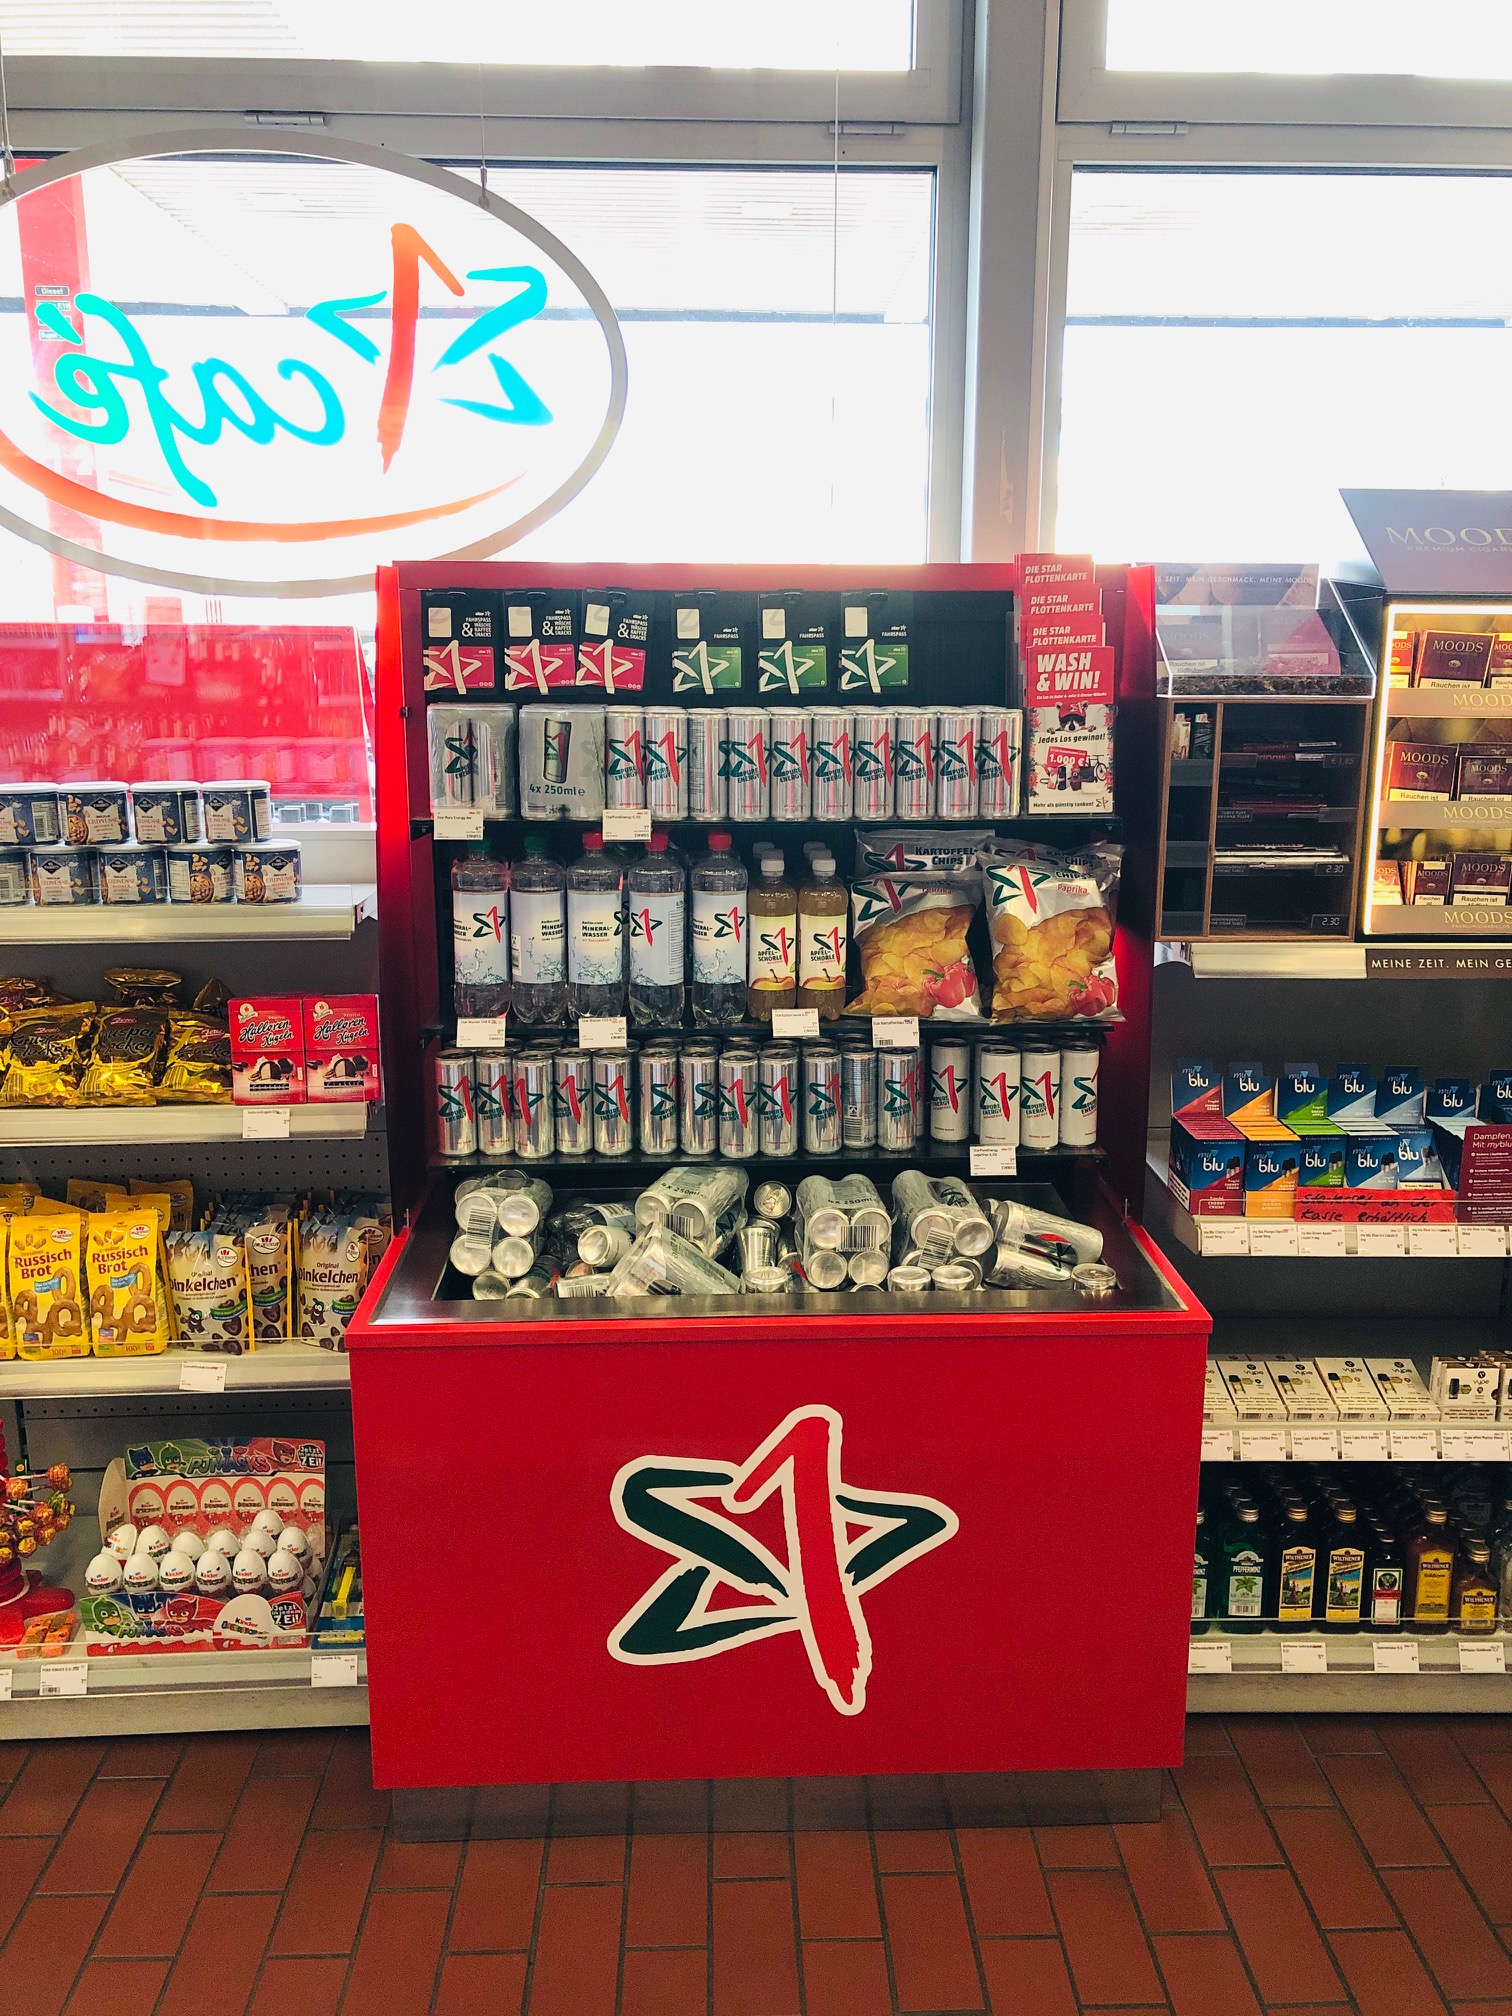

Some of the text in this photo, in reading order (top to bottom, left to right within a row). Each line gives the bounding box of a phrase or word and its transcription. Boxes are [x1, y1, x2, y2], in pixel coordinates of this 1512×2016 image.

[41, 287, 64, 295] Diesel
[1025, 563, 1062, 575] DIE STAR
[1025, 572, 1088, 584] FLOTTENKARTE
[1031, 594, 1068, 605] DIE STAR
[1030, 603, 1094, 615] FLOTTENKARTE
[461, 622, 474, 637] &
[542, 621, 555, 636] &
[617, 623, 630, 638] &
[1033, 626, 1071, 636] DIE STAR
[1033, 634, 1097, 647] FLOTTENKARTE
[1432, 640, 1484, 652] MOODS
[1037, 652, 1092, 673] WASH
[1036, 671, 1100, 692] & WIN!
[1430, 681, 1460, 689] Rauchen
[1038, 736, 1058, 744] Jedes
[1060, 735, 1071, 743] Los
[1400, 751, 1449, 765] MOODS
[1470, 763, 1507, 772] MOODS
[529, 784, 577, 796] 4x 250ml
[1400, 793, 1428, 801] Rauchen
[915, 846, 978, 857] KARTOFFEL-
[932, 856, 963, 866] CHIPS
[1064, 856, 1095, 868] CHIPS
[1461, 862, 1506, 873] MOODS
[1325, 865, 1344, 873] 2.30
[1417, 869, 1448, 877] MOODS
[1057, 883, 1088, 894] Paprika
[1321, 917, 1340, 926] 2.30
[1371, 958, 1412, 968] MEINE
[1418, 958, 1449, 968] ZEIT.
[1456, 959, 1489, 968] MEIN
[239, 1019, 291, 1042] Halloren
[314, 1017, 366, 1040] Halloren
[262, 1031, 294, 1048] Kugeln
[336, 1029, 369, 1045] Kugeln
[1188, 1074, 1209, 1087] blu
[1239, 1078, 1260, 1092] blu
[1294, 1079, 1315, 1093] blu
[1344, 1079, 1365, 1093] blu
[1392, 1081, 1413, 1095] blu
[1443, 1094, 1464, 1108] blu
[1399, 1147, 1420, 1161] blu
[1203, 1158, 1224, 1172] blu
[1259, 1159, 1280, 1173] blu
[1305, 1154, 1326, 1168] blu
[1358, 1154, 1379, 1168] blu
[14, 1249, 72, 1269] Russisch
[92, 1245, 149, 1264] Russisch
[21, 1264, 53, 1280] Brot
[98, 1259, 128, 1275] Brot
[187, 1456, 272, 1475] PJ MASKS
[309, 1455, 323, 1467] Ei!
[1232, 1565, 1261, 1574] PFEFFERMINZ
[235, 1617, 259, 1629] kinder
[284, 1613, 302, 1625] Ei!
